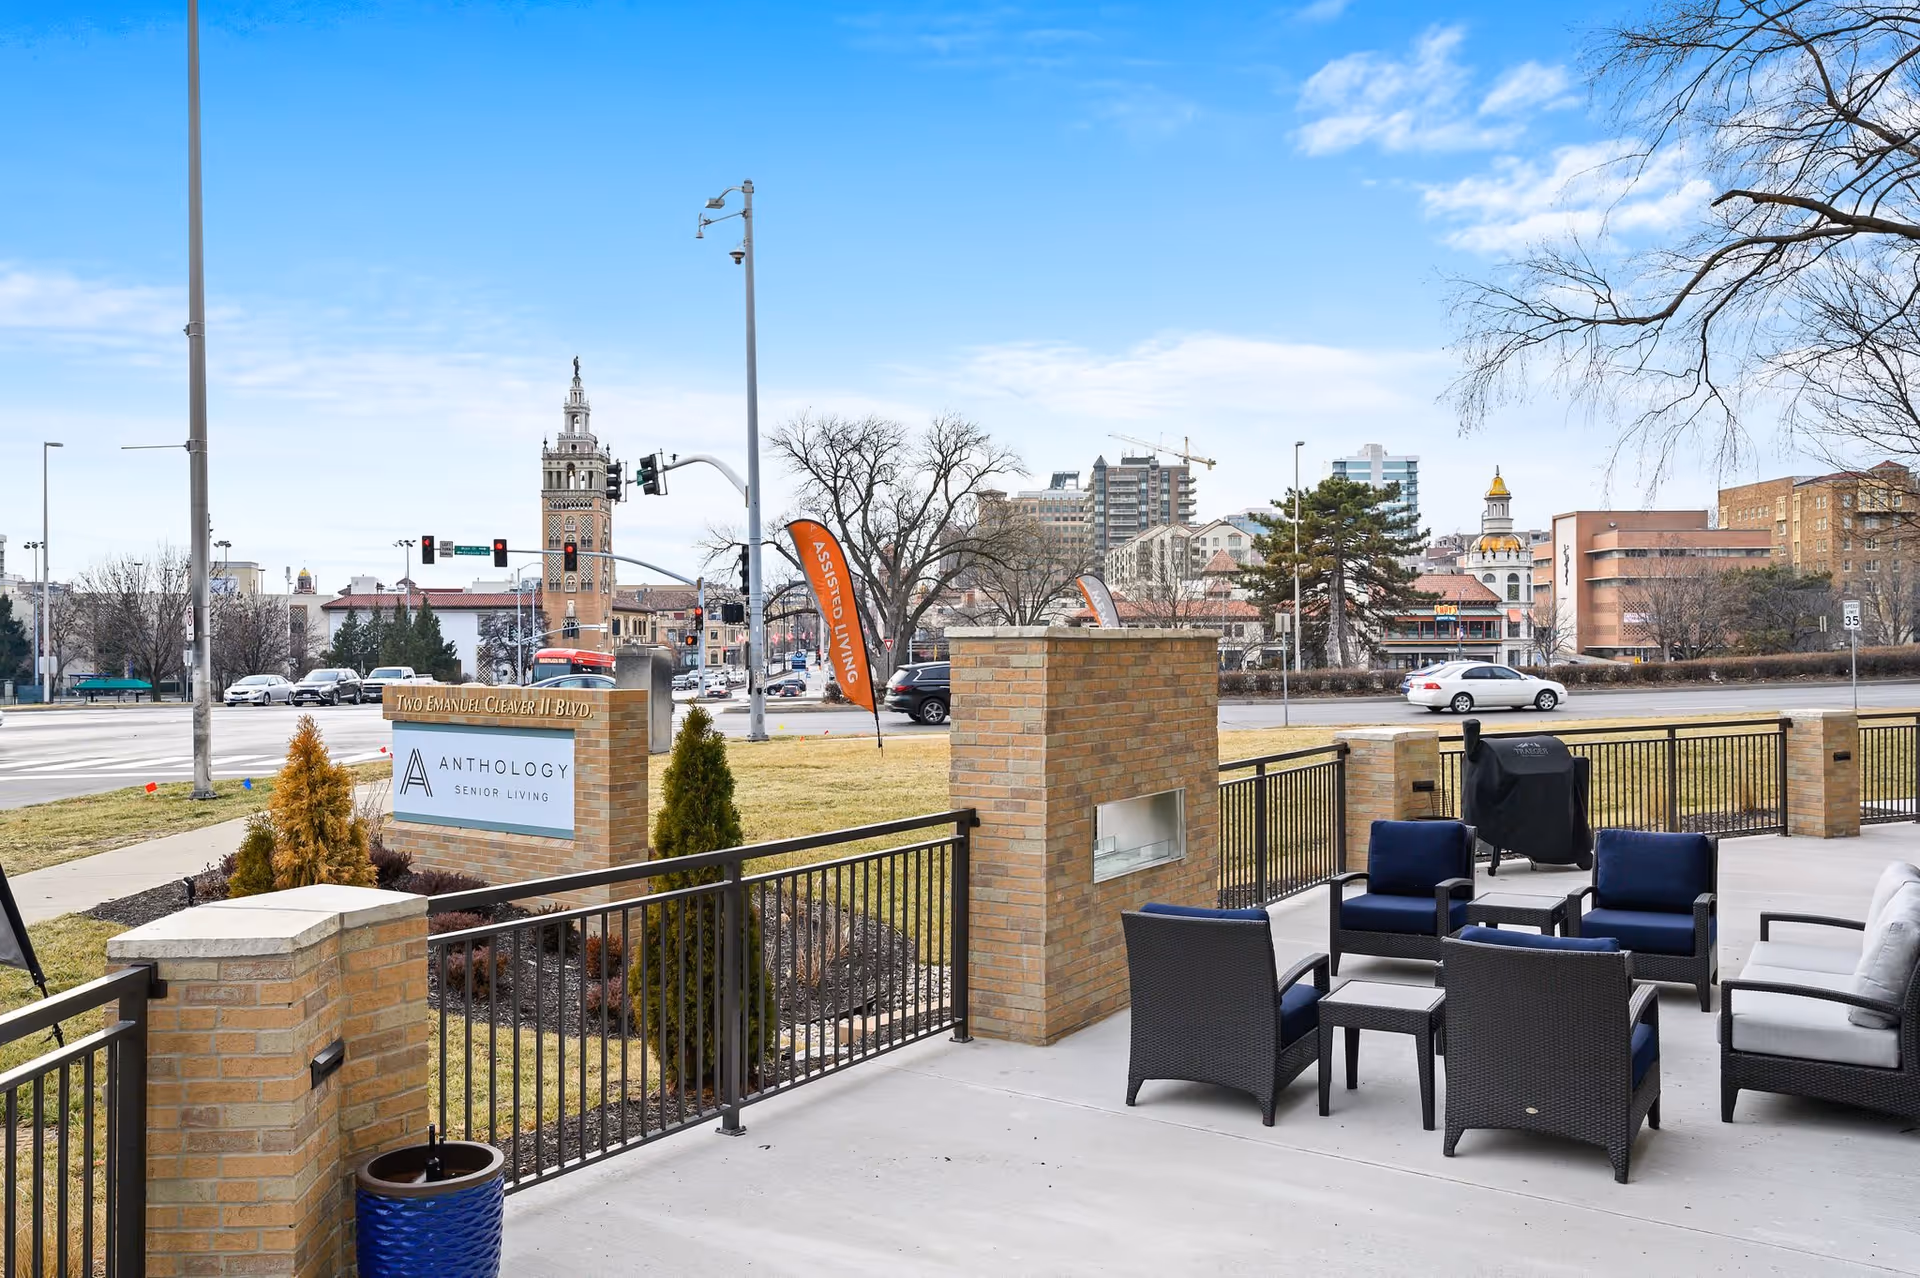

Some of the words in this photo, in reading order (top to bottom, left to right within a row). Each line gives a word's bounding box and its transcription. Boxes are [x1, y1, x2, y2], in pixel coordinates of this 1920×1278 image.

[812, 540, 844, 620] ASSISTED
[834, 623, 859, 685] LIVING
[1845, 615, 1859, 626] 35
[539, 697, 551, 716] II
[1514, 747, 1549, 755] TRAEGER
[439, 756, 568, 779] ANTHOLOGY
[454, 785, 499, 798] SENIOR
[507, 790, 549, 802] LIVING
